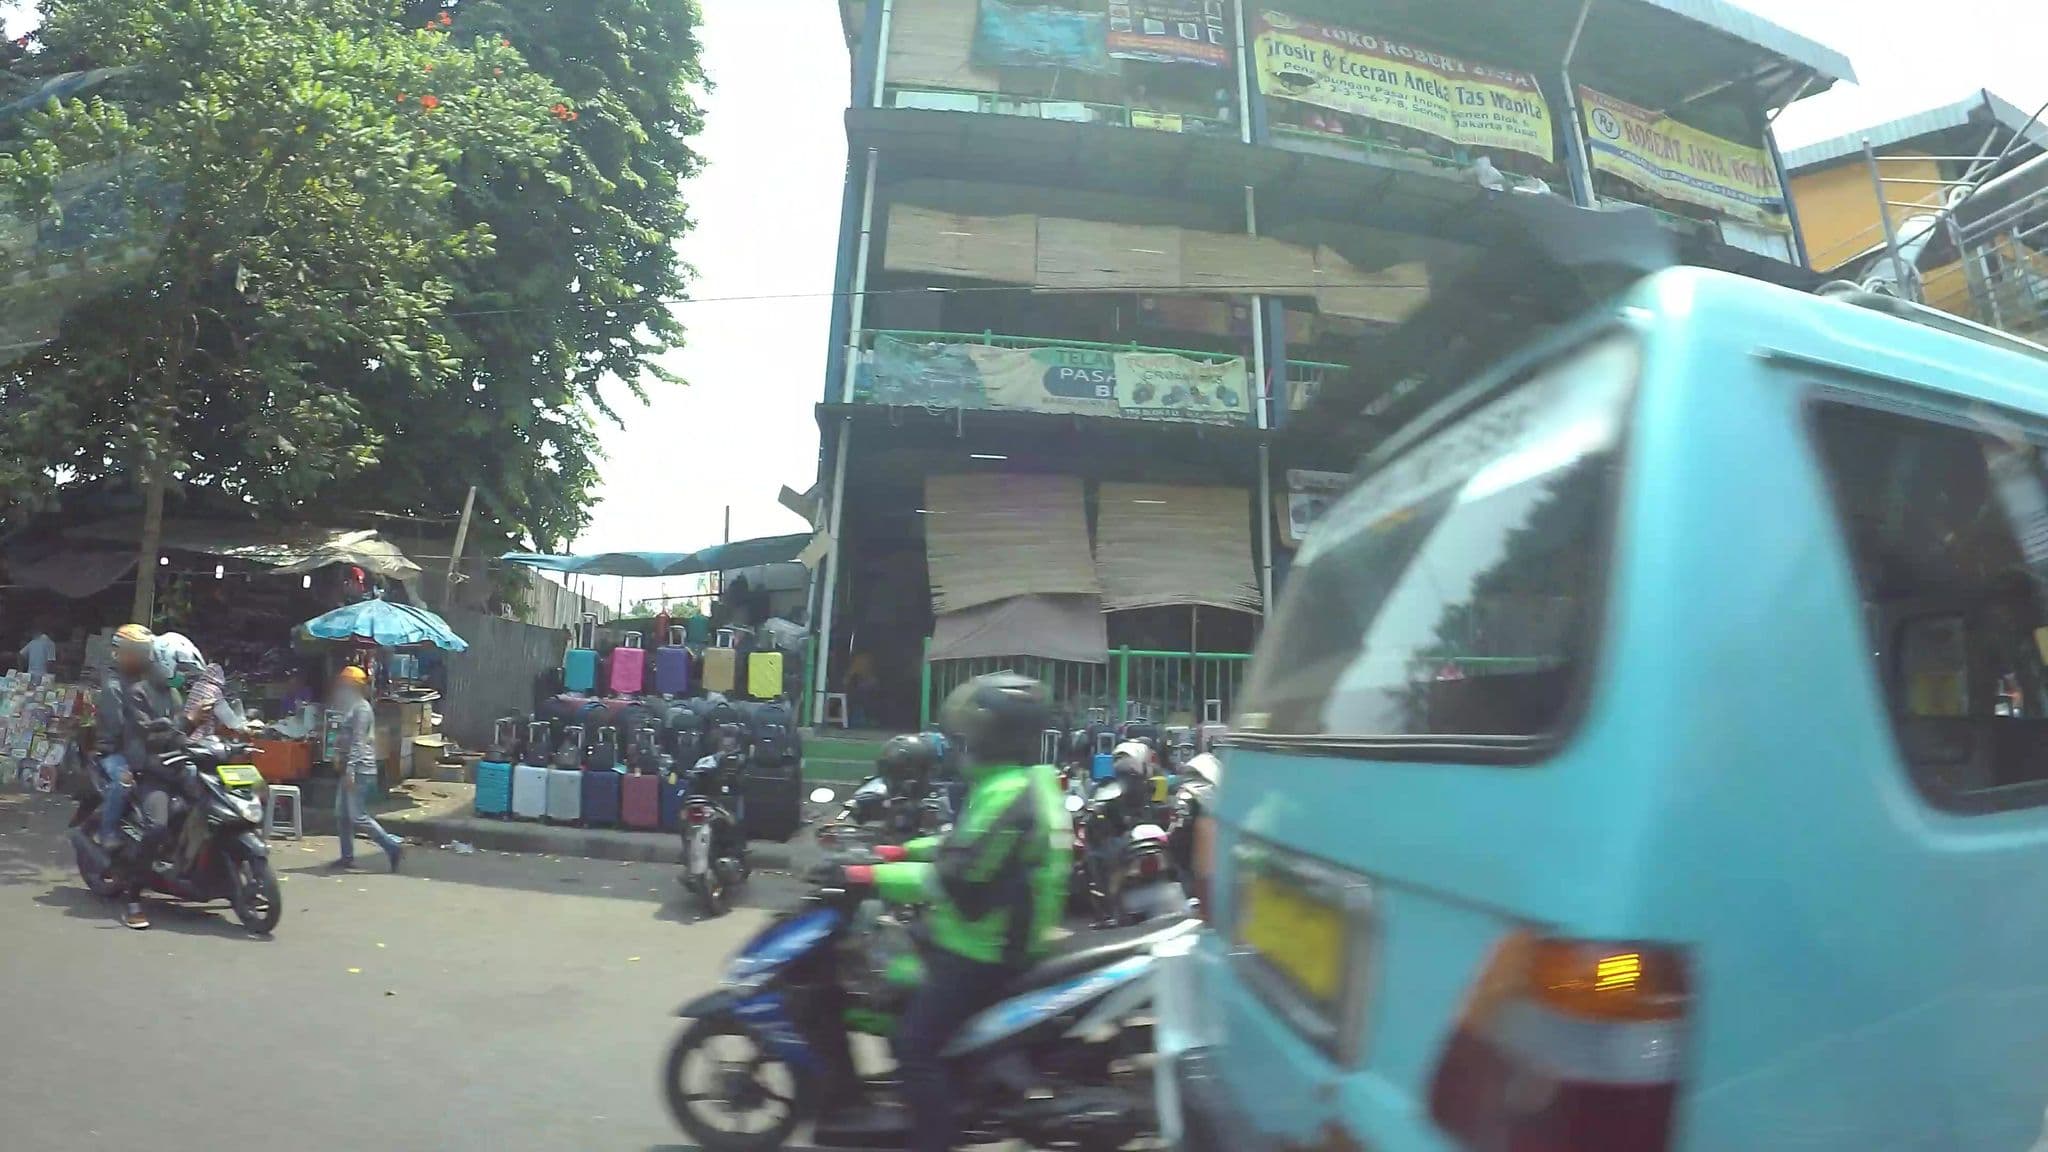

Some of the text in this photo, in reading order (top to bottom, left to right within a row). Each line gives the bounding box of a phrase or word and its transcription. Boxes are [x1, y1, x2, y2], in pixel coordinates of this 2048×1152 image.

[1340, 56, 1398, 86] Eceran
[1404, 71, 1450, 103] Aneka
[1456, 86, 1486, 106] Tas
[1490, 90, 1542, 120] Wanita
